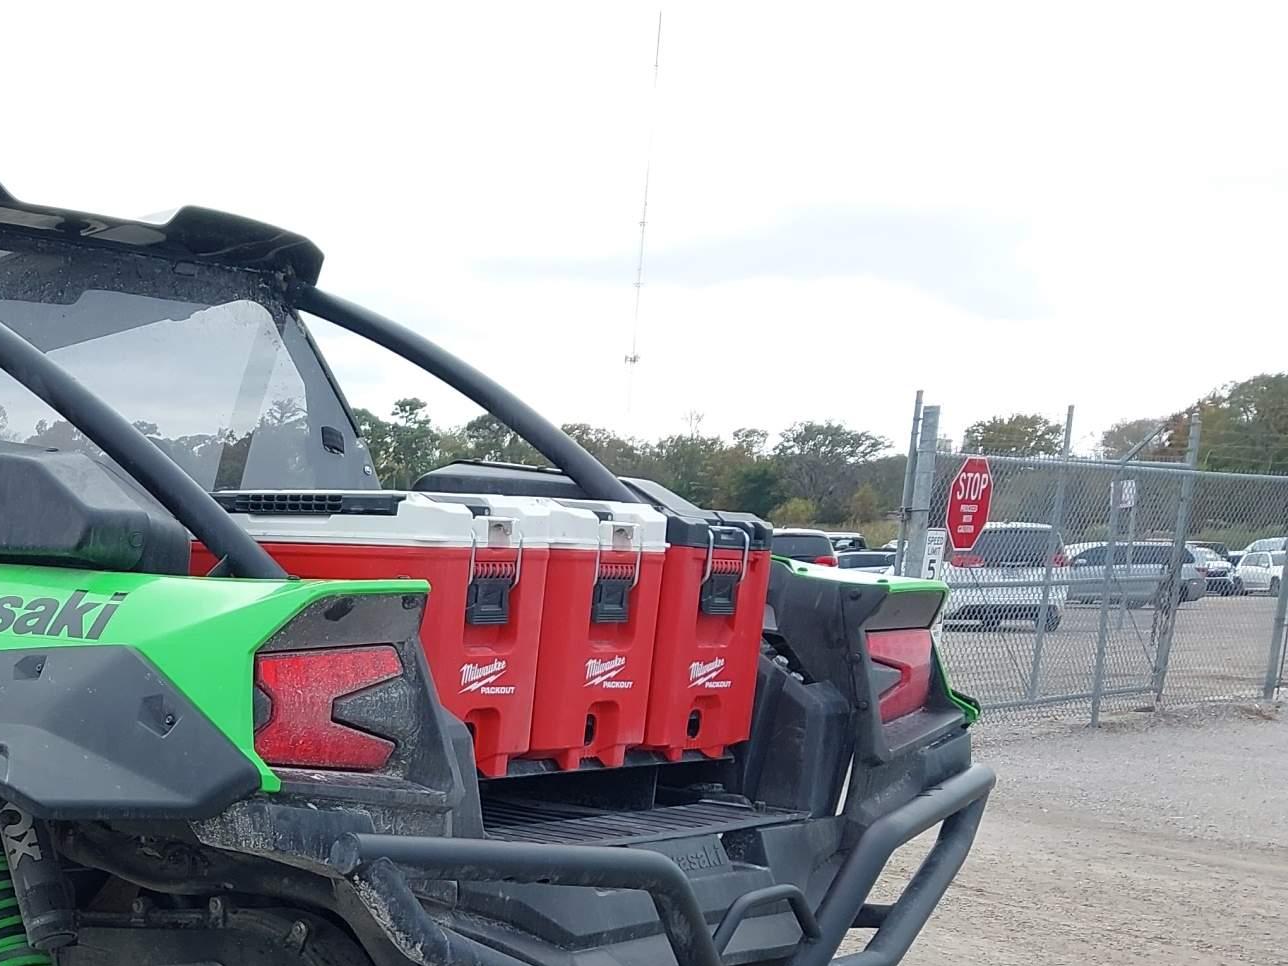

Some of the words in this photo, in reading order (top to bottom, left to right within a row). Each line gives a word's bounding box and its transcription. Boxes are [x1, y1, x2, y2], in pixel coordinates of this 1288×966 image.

[957, 472, 988, 500] STOP
[927, 536, 943, 545] SPEED
[927, 547, 941, 555] LIMIT
[927, 559, 936, 579] 5
[460, 659, 507, 686] Milwaukee
[585, 656, 626, 679] Milwaukee
[688, 657, 725, 681] Milwaukee
[480, 686, 516, 694] PACKOUT
[602, 680, 633, 689] PACKOUT
[705, 680, 731, 689] PACKOUT
[674, 845, 722, 872] asaki
